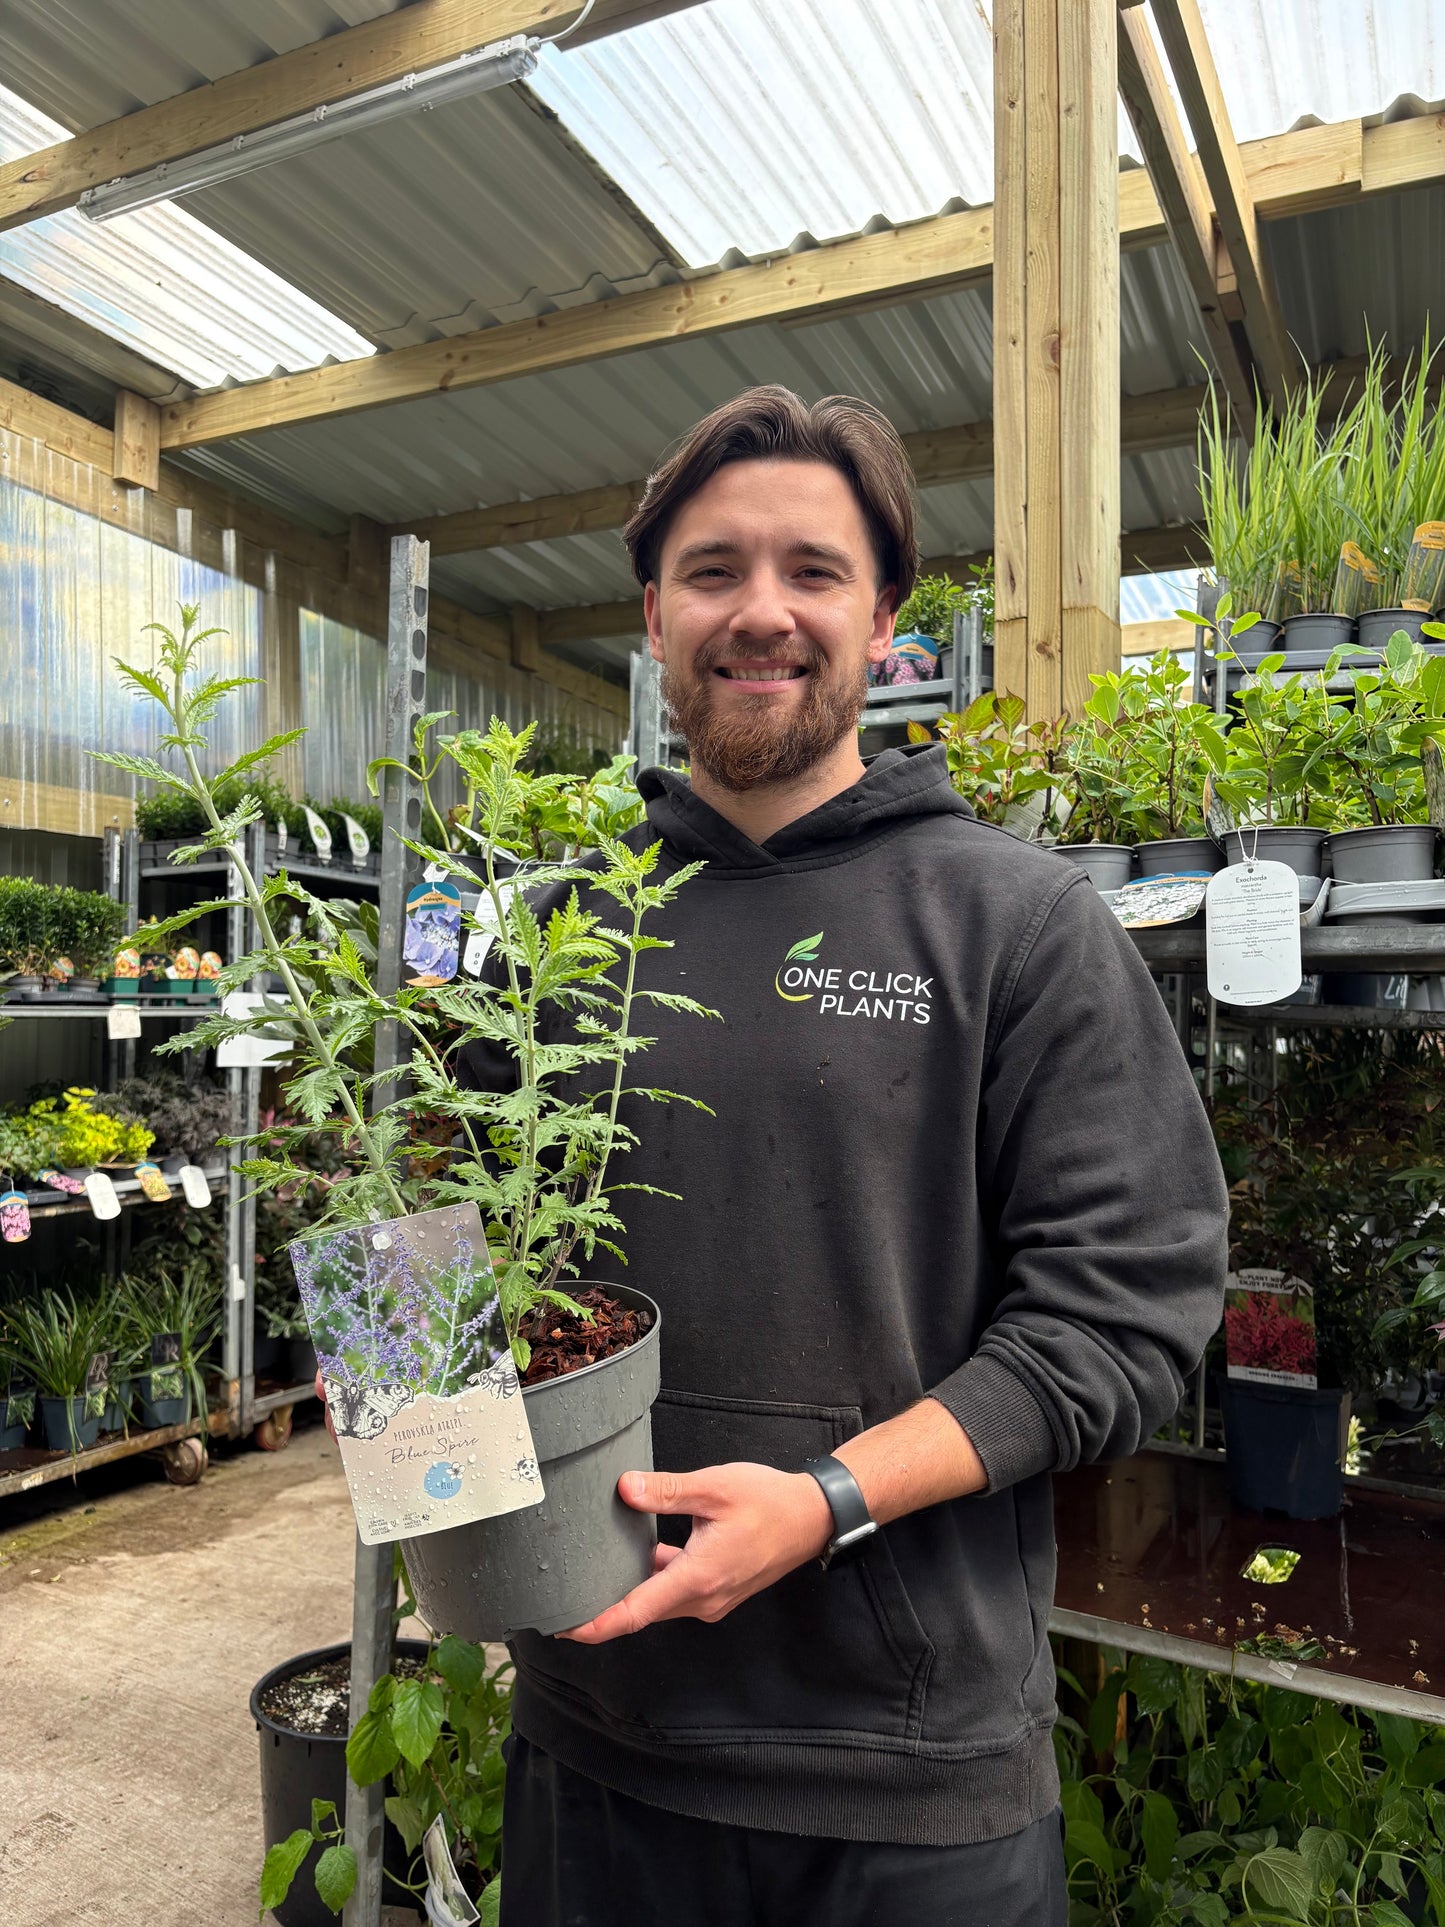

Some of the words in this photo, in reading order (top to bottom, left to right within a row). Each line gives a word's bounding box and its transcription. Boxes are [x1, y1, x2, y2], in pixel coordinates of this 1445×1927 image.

[1235, 874, 1268, 884] Exochorda
[784, 966, 842, 989] ONE
[848, 970, 934, 999] CLICK
[819, 994, 931, 1025] PLANTS
[393, 1424, 435, 1442] PEROVSKIA
[385, 1445, 431, 1464] Blue
[431, 1437, 480, 1458] Spire
[440, 1481, 454, 1490] BLUE
